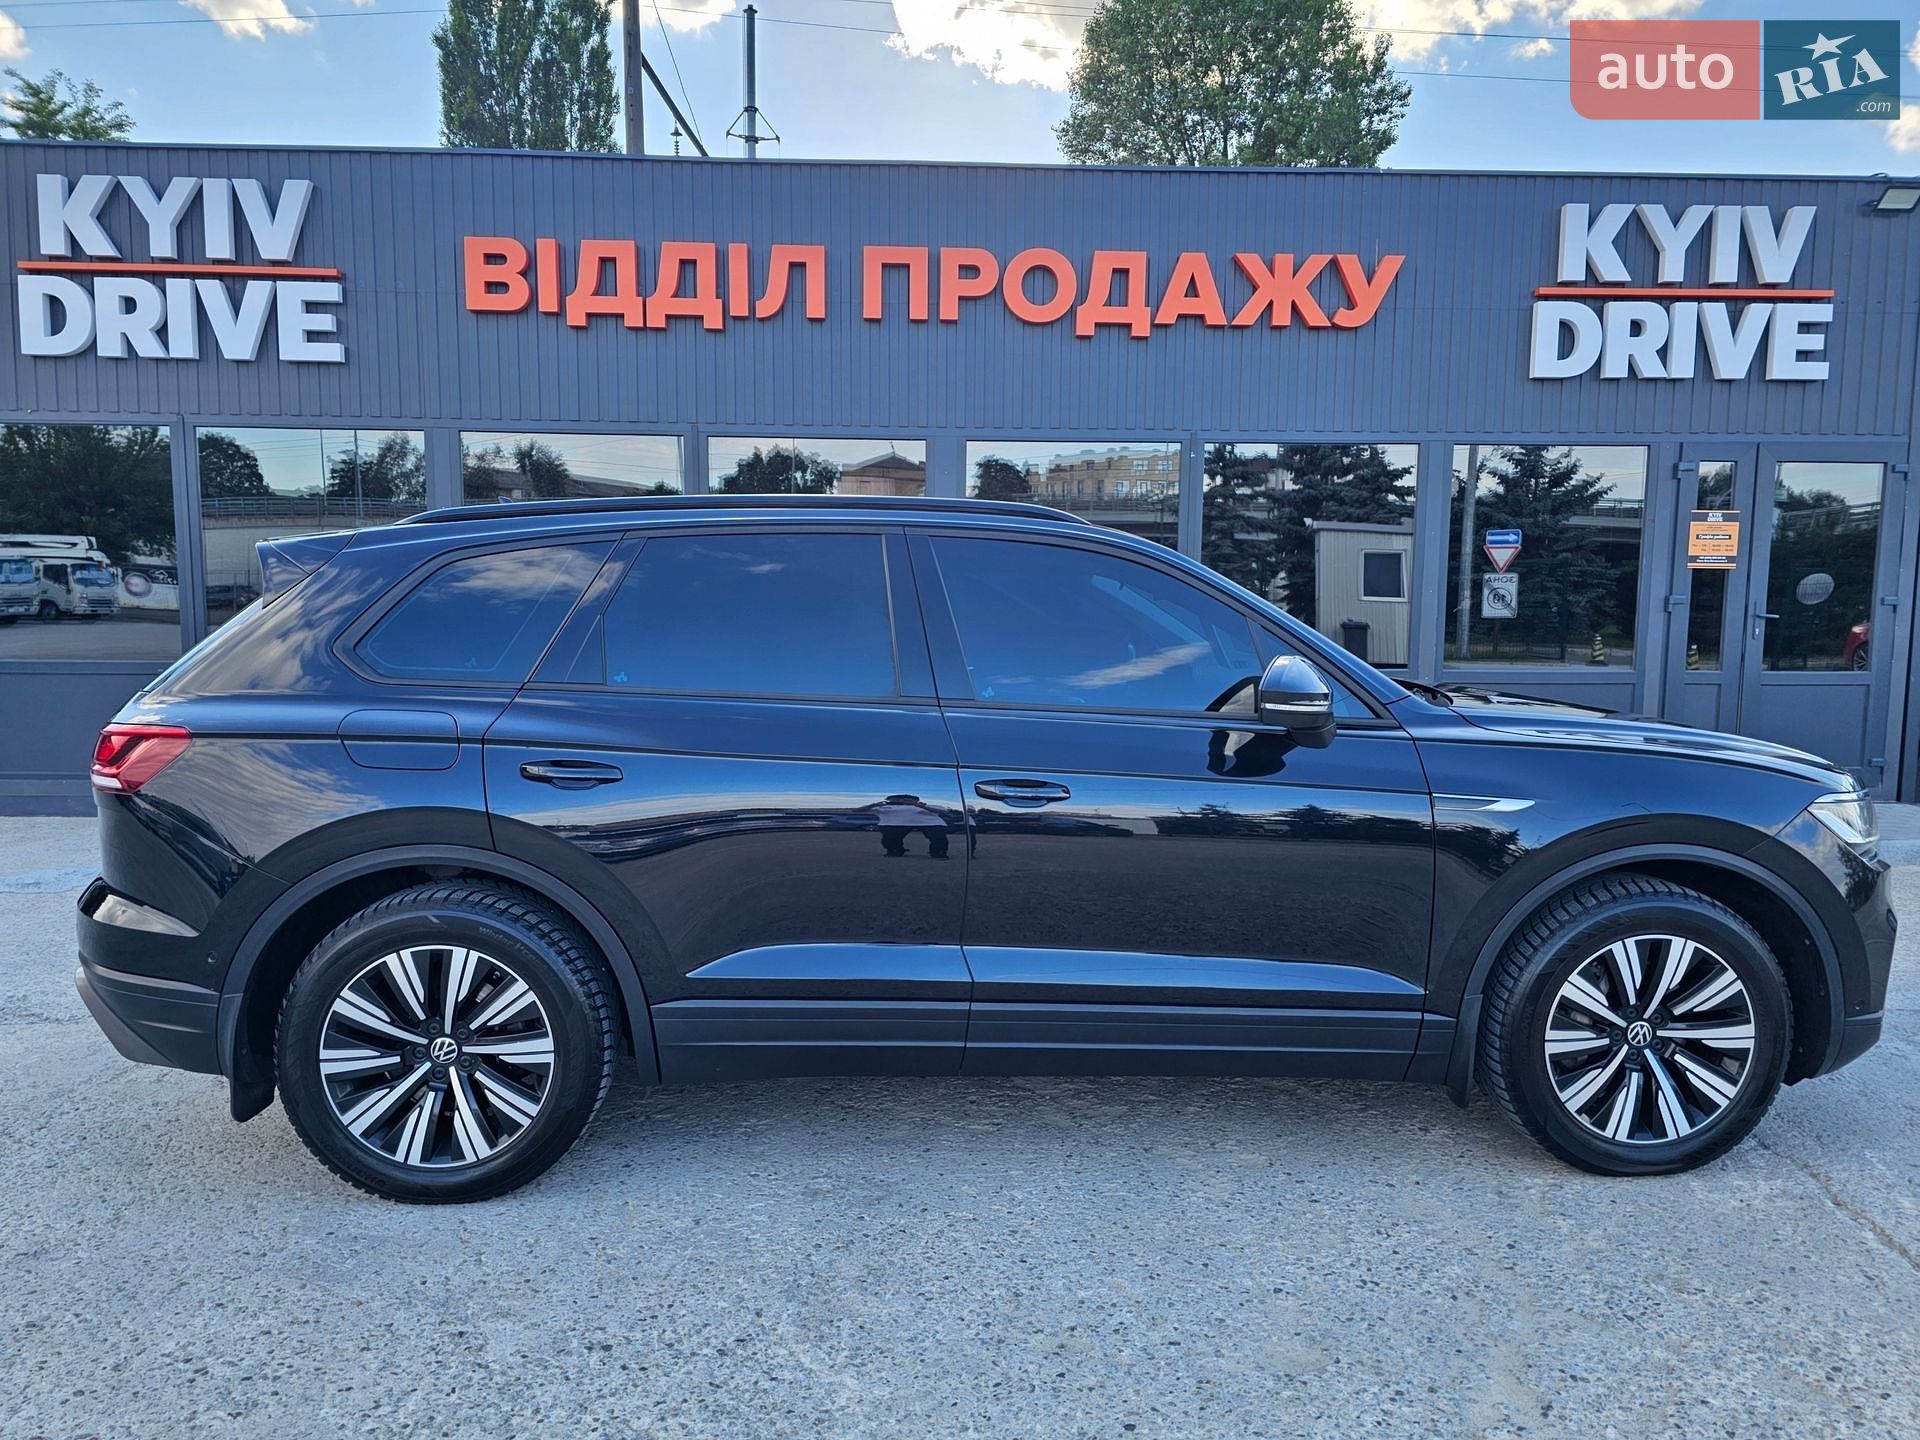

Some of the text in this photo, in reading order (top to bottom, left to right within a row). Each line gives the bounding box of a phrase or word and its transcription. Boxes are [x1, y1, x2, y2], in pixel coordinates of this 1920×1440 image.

[36, 173, 314, 262] KYIV
[1557, 203, 1817, 285] KYIV
[17, 274, 345, 363] DRIVE
[463, 236, 1406, 338] ВІДДІЛ ПРОДАЖУ
[1529, 300, 1834, 381] DRIVE
